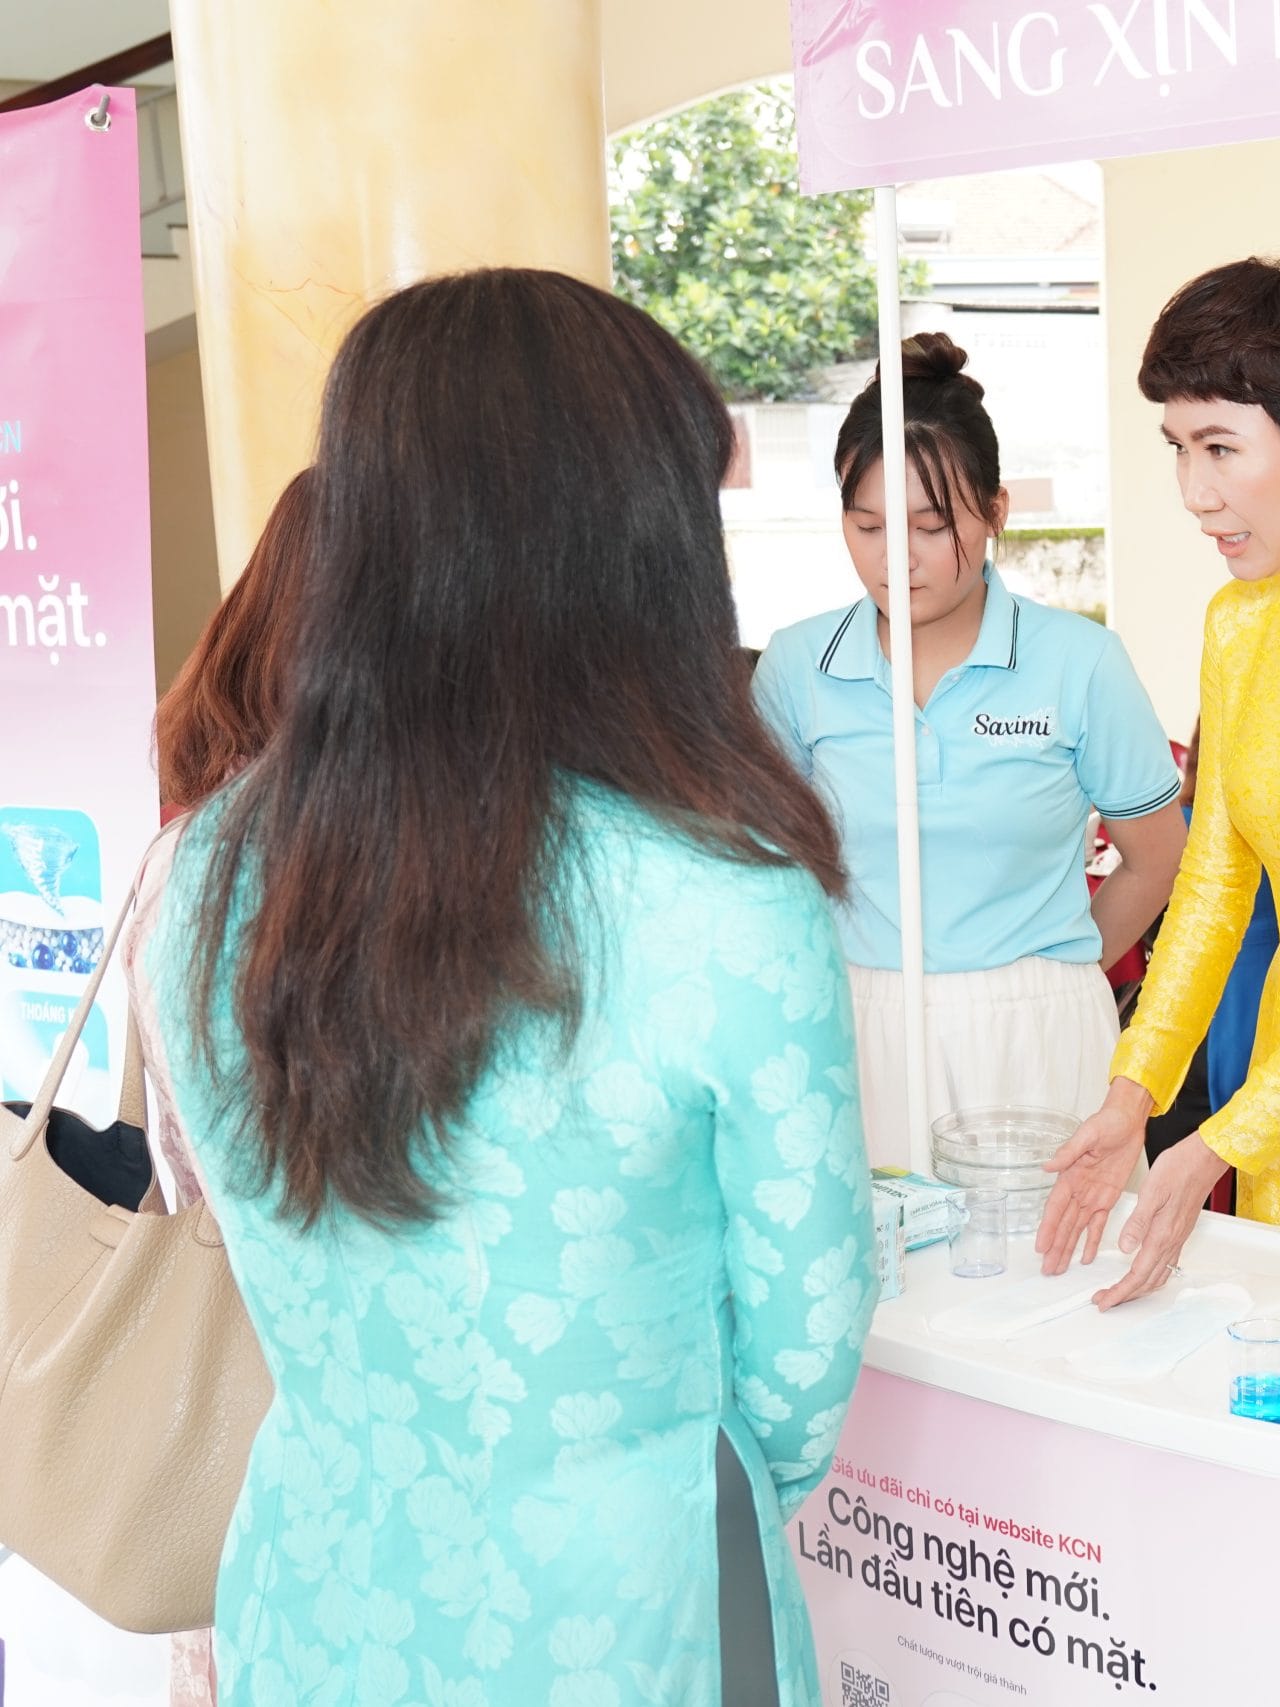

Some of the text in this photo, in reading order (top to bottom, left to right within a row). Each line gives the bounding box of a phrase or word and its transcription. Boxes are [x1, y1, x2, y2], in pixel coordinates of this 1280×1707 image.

[856, 12, 1068, 120] SANG
[1086, 0, 1239, 98] XỊN
[0, 574, 107, 666] mặt.
[974, 713, 1052, 737] Saximi
[828, 1487, 1110, 1621] Công nghệ mới.
[832, 1455, 854, 1479] Giá
[880, 1476, 903, 1499] đãi
[906, 1487, 931, 1509] chỉ
[934, 1497, 955, 1517] có
[958, 1503, 980, 1528] tại
[983, 1514, 1054, 1549] website
[1058, 1533, 1102, 1564] KCN
[799, 1520, 1157, 1691] Lần đầu tiên có mặt.
[897, 1635, 1027, 1697] Chất lượng vượt trội giá thành
